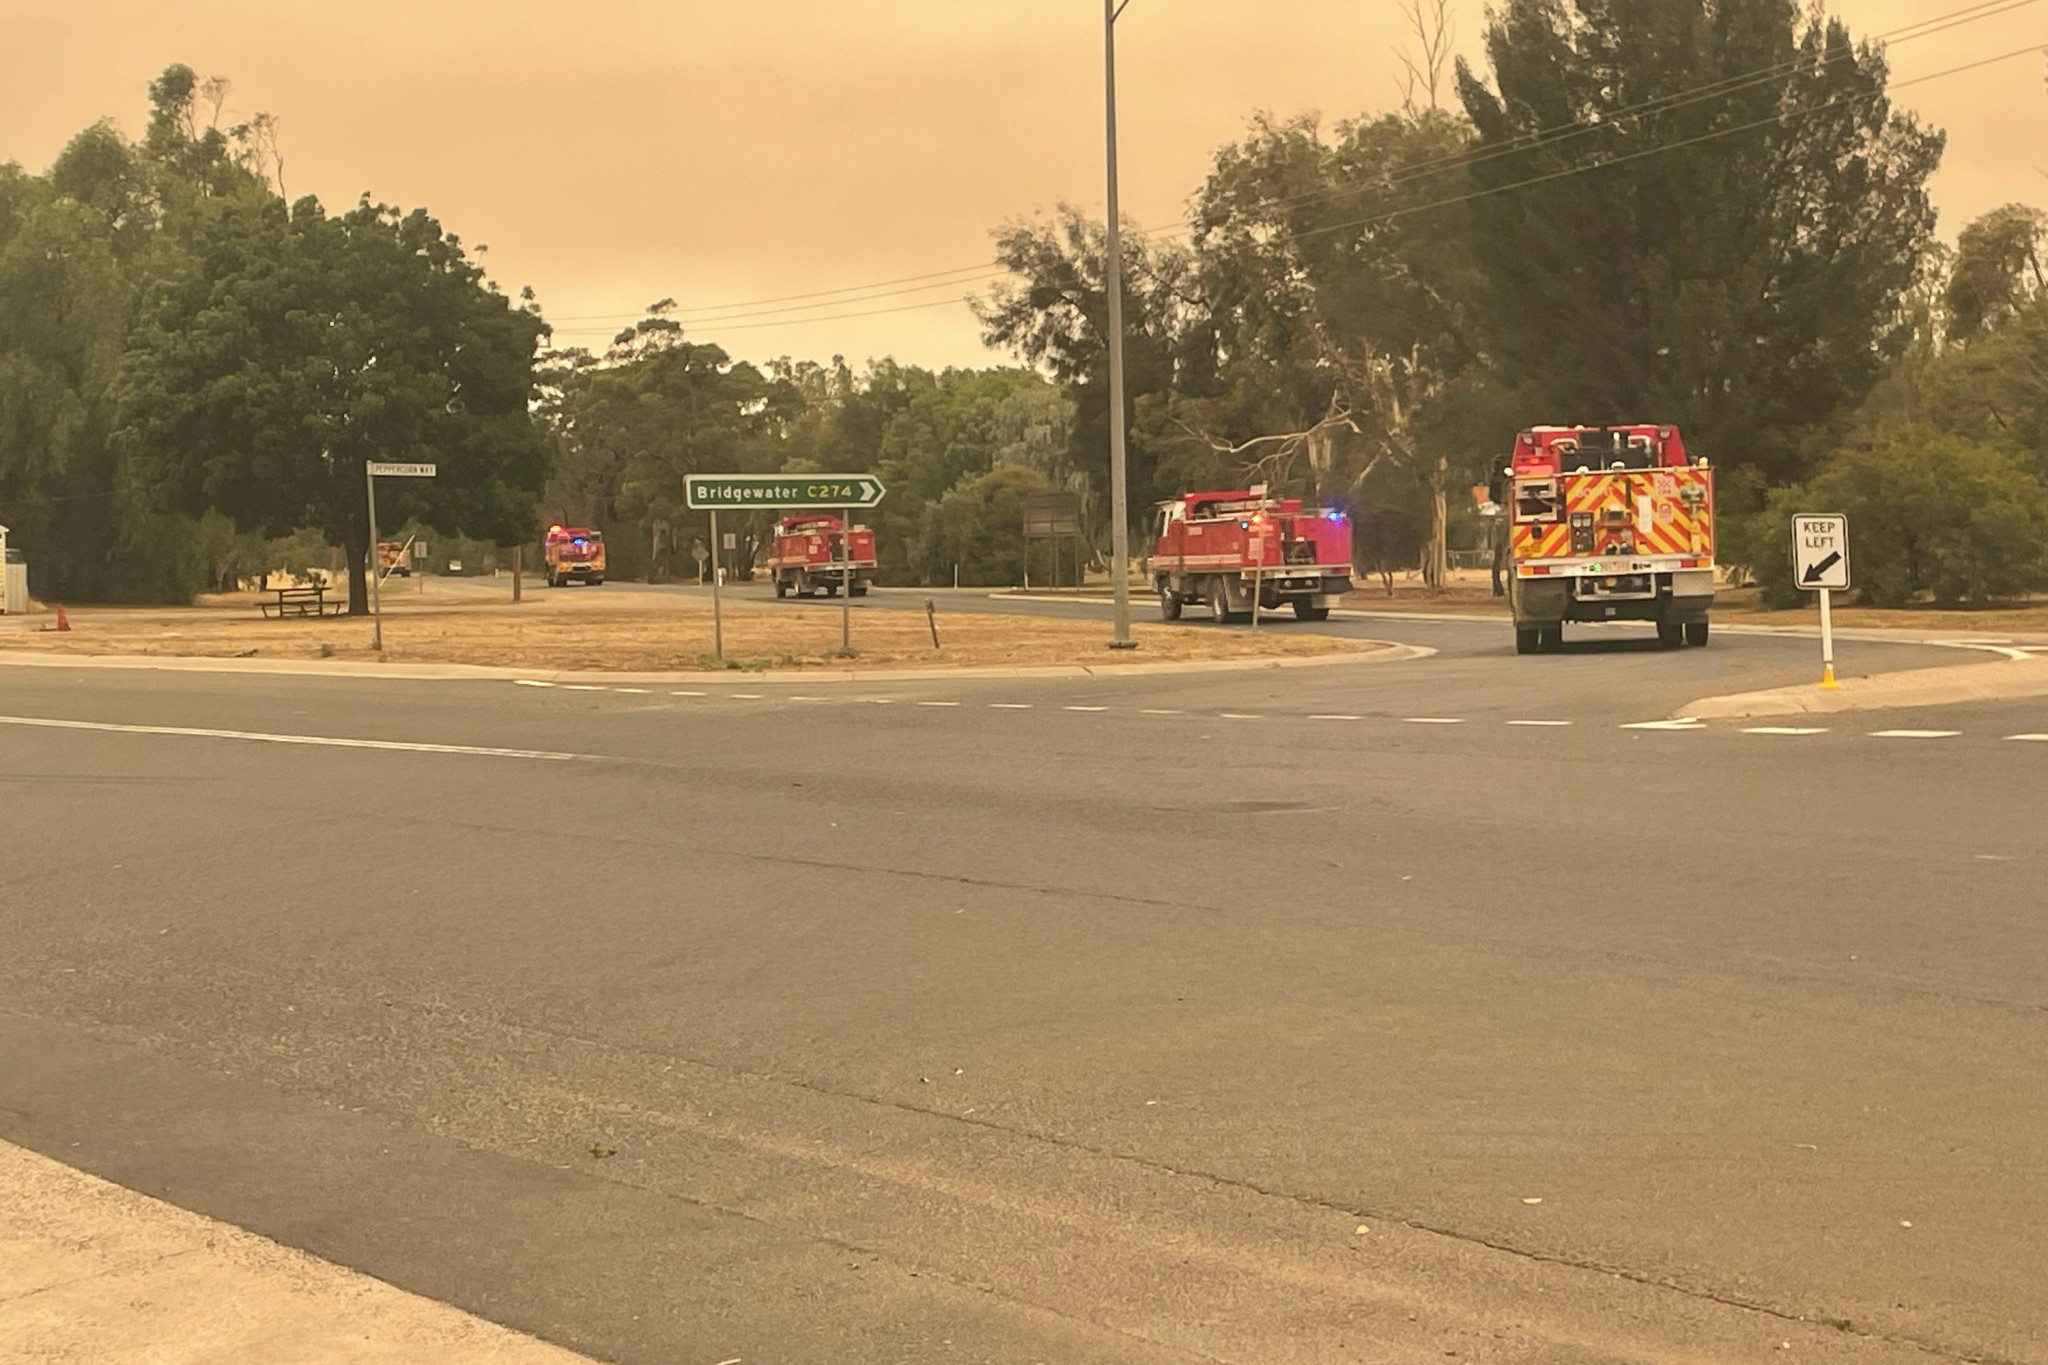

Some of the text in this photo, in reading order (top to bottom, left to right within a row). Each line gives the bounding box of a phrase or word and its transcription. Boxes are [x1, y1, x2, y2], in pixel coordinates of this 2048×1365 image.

[419, 466, 434, 474] WAY
[697, 485, 852, 502] Bridgewater C274
[1803, 522, 1836, 533] KEEP
[1805, 537, 1835, 548] LEFT
